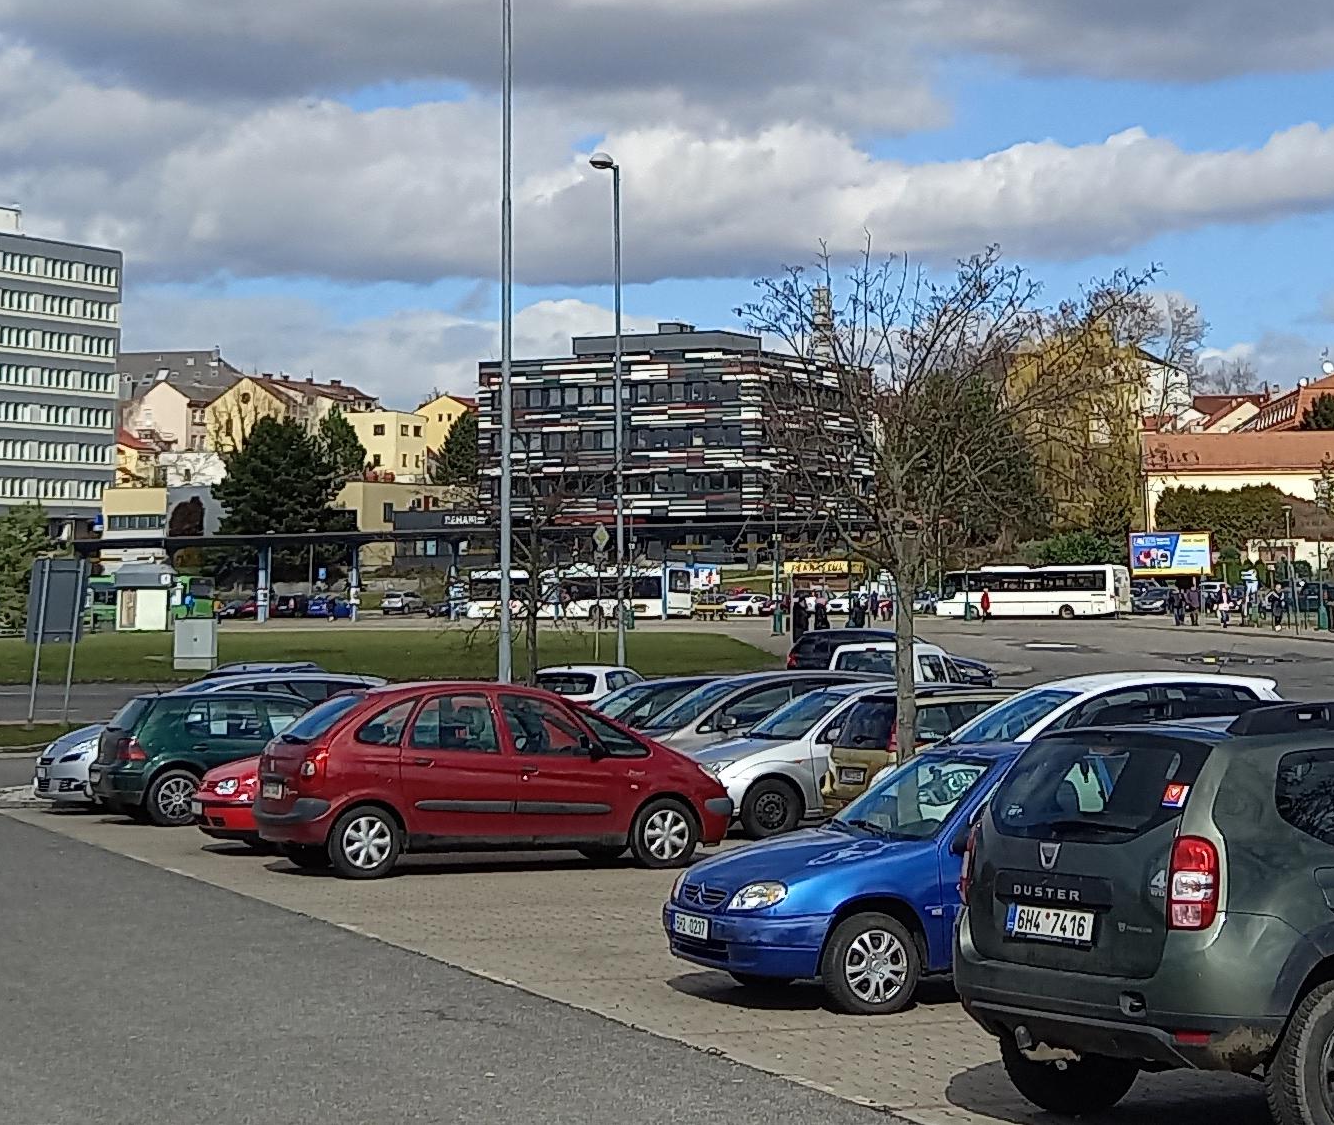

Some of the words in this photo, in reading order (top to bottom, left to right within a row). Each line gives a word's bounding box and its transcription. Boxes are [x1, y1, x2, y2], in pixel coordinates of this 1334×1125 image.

[1013, 884, 1080, 901] DUSTER
[1018, 909, 1041, 932] 6H4
[1050, 912, 1087, 937] 7416
